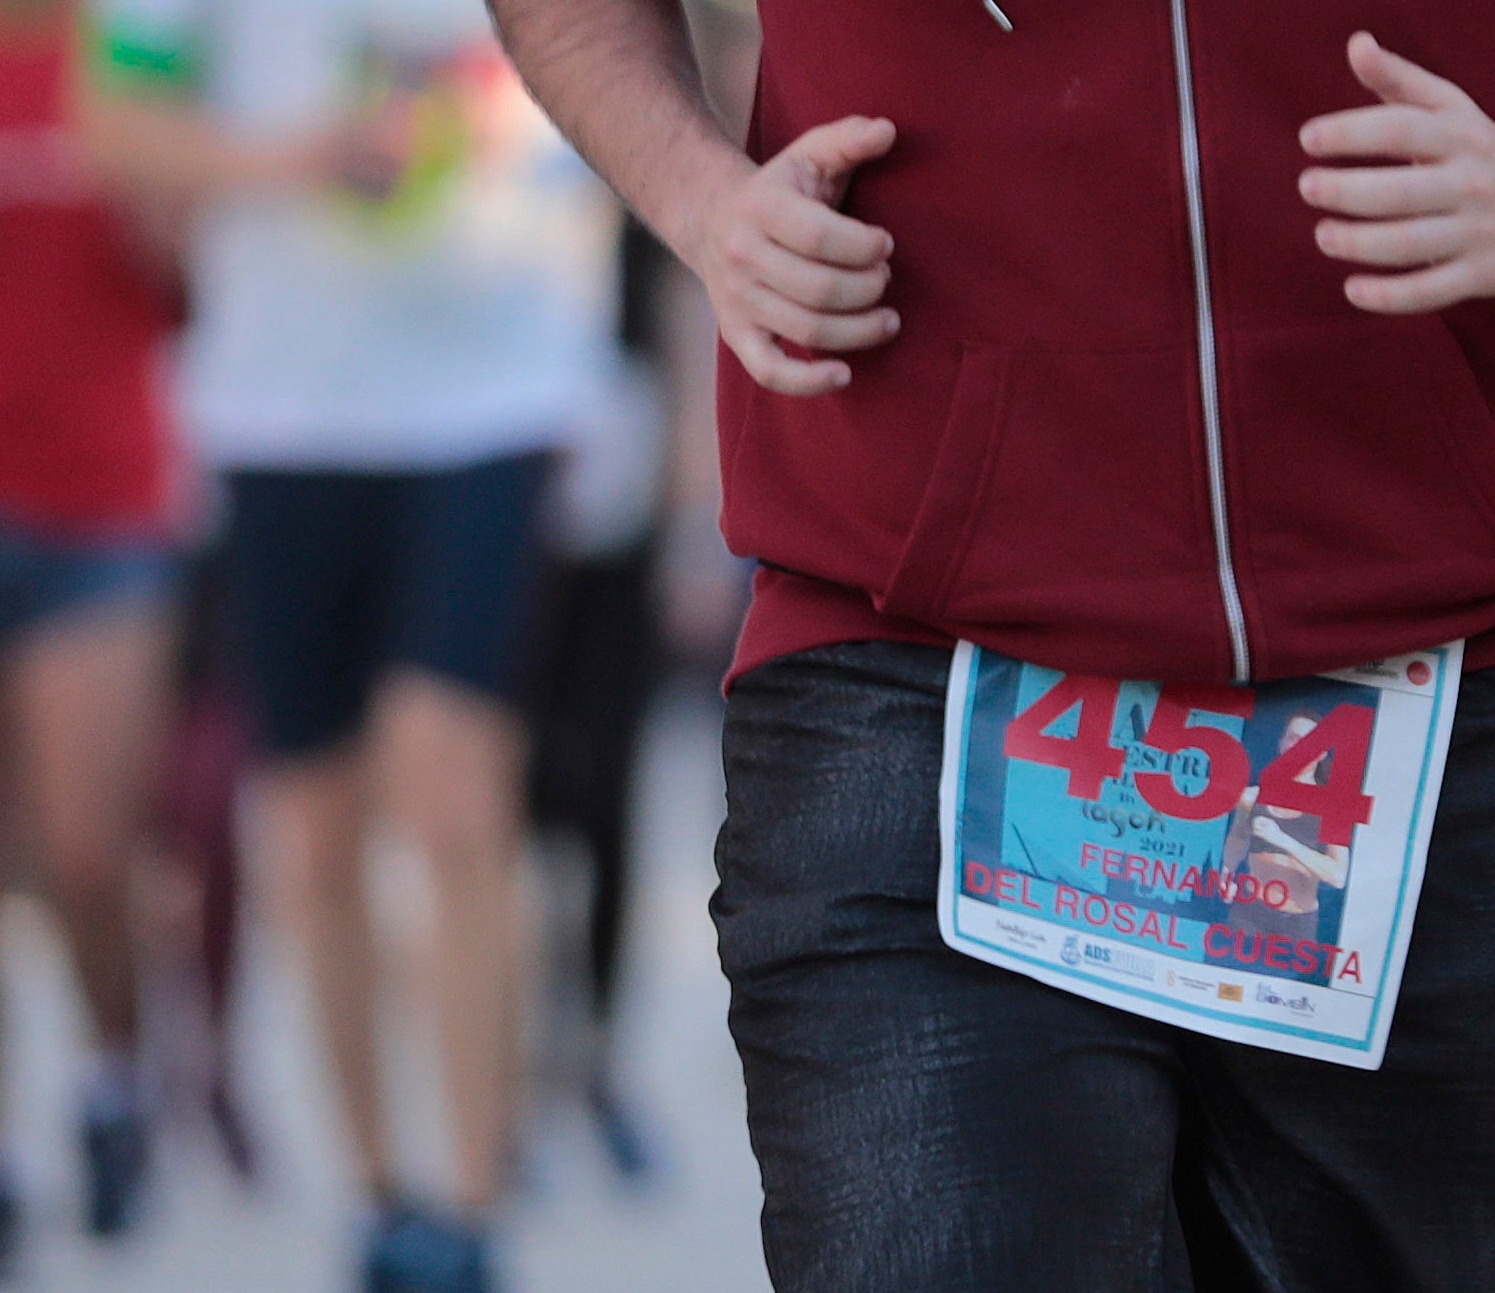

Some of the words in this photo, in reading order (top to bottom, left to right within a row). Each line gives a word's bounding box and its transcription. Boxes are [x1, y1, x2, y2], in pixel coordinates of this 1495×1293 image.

[1003, 673, 1376, 847] 454
[1080, 843, 1290, 909] FERNANDO
[1139, 837, 1186, 857] 2021
[965, 862, 1042, 910] DEL
[1054, 884, 1188, 950] ROSAL
[1203, 922, 1362, 984] CUESTA
